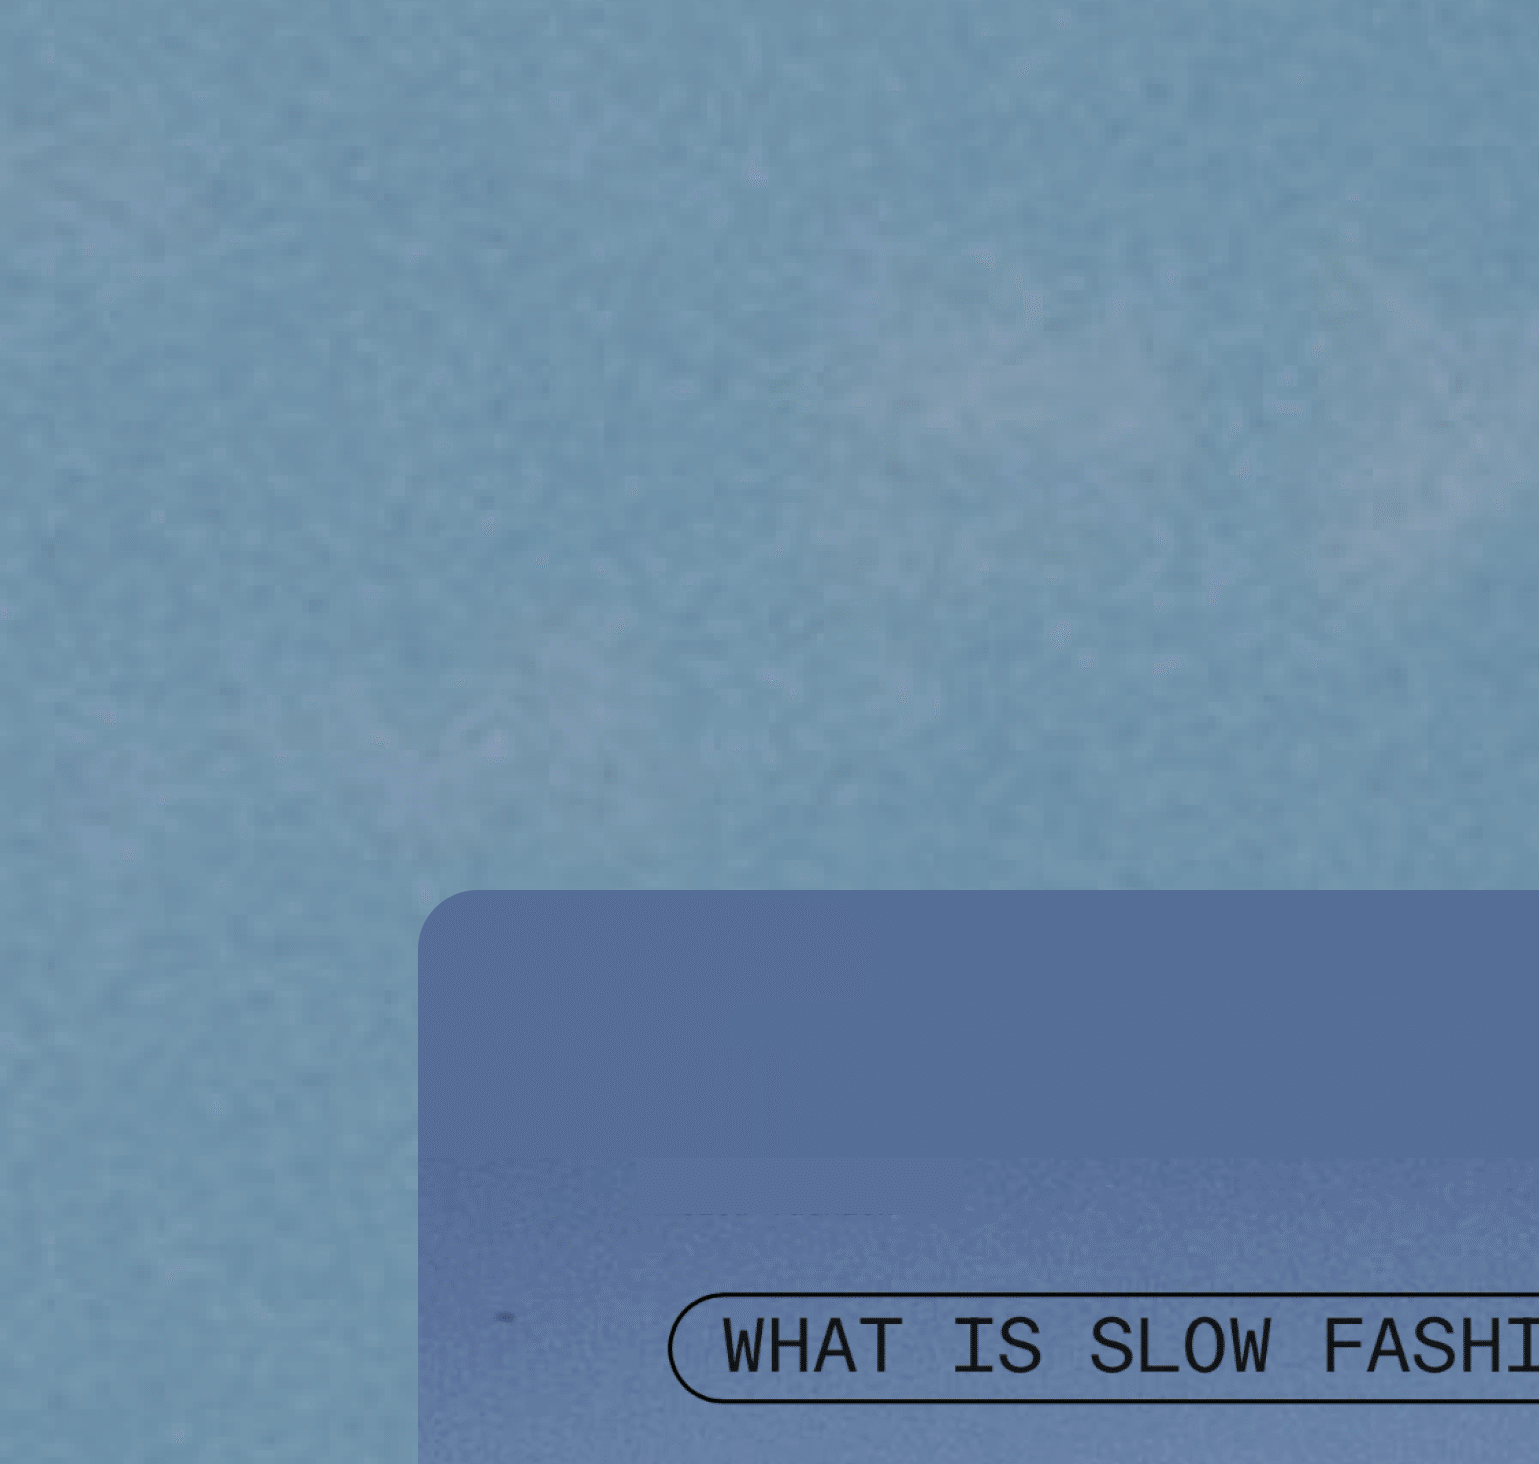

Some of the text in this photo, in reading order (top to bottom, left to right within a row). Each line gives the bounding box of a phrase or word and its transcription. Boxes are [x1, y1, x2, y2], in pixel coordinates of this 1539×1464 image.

[722, 1317, 903, 1373] WHAT
[954, 1316, 1041, 1374] IS
[1090, 1316, 1272, 1374] SLOW
